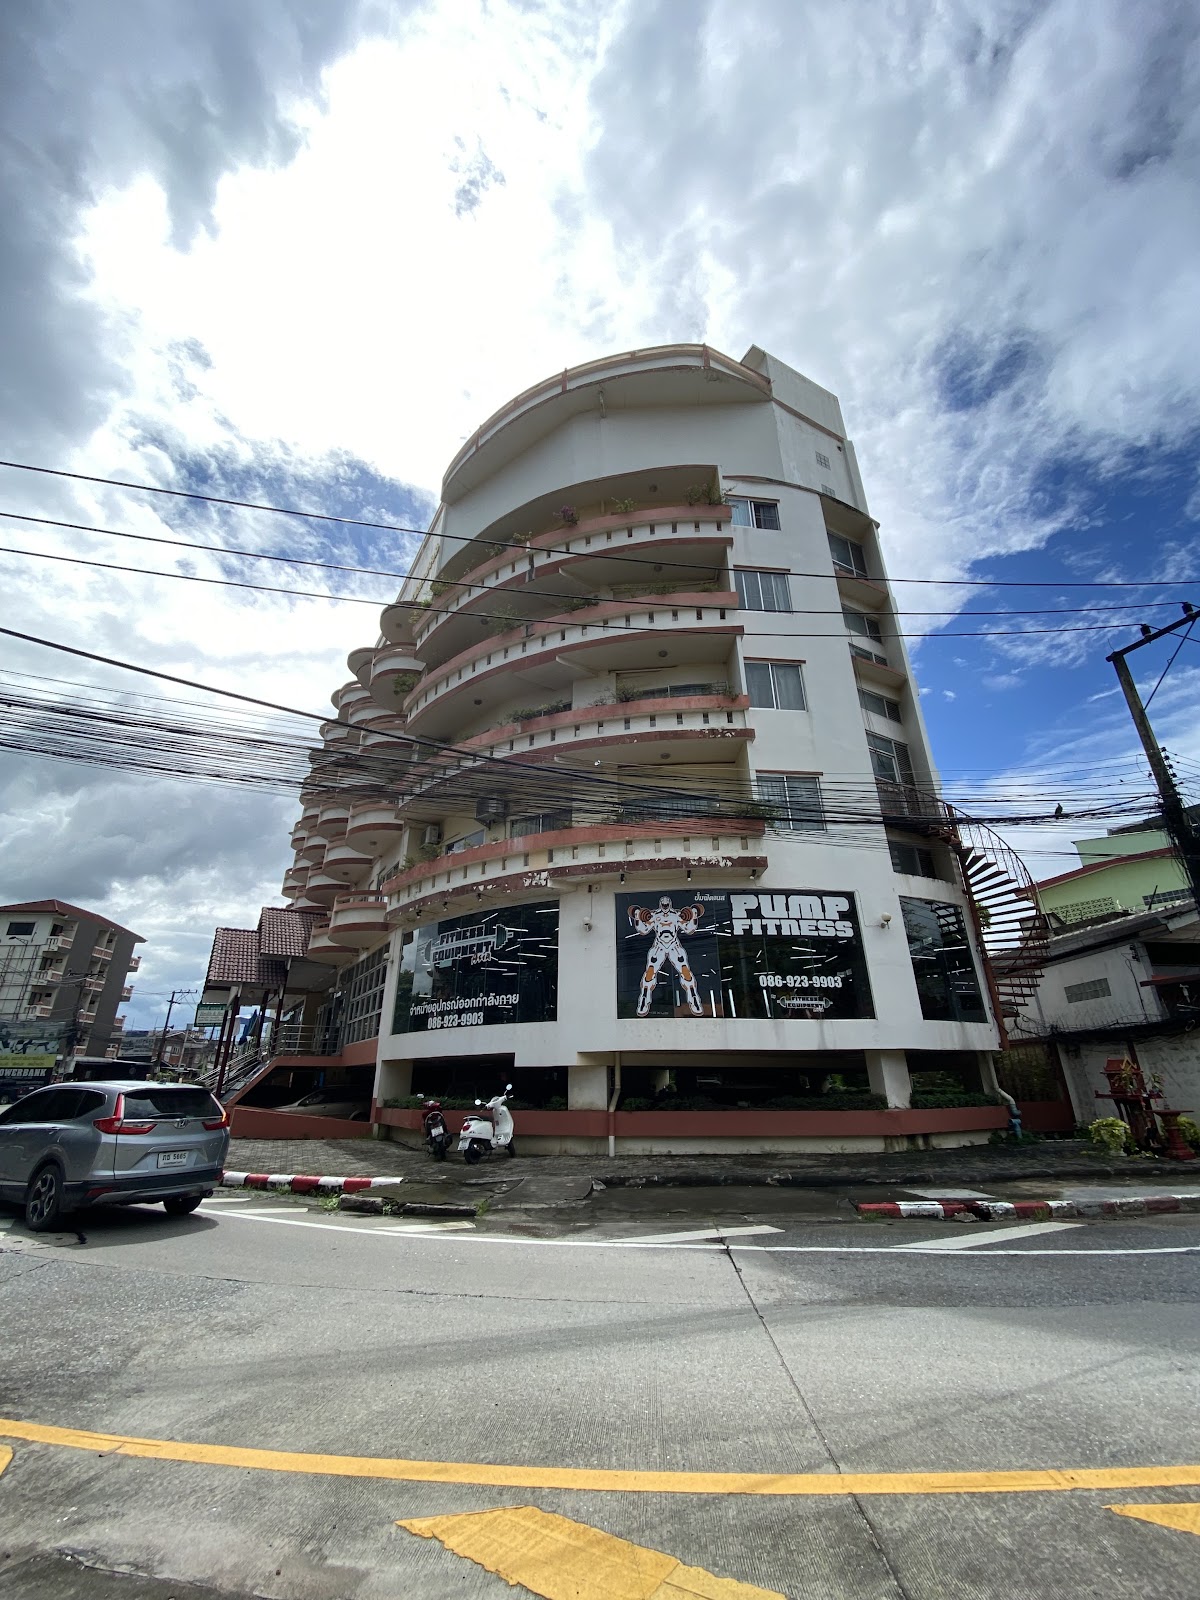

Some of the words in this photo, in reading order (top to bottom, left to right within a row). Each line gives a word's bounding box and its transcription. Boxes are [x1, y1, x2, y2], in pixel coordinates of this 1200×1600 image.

[730, 895, 849, 920] PUMP
[439, 925, 485, 946] FITNESS
[732, 919, 854, 937] FITNESS
[432, 941, 492, 963] EQUIPMENT
[759, 975, 842, 988] 086-923-9903
[427, 1012, 484, 1029] 086-923-9903
